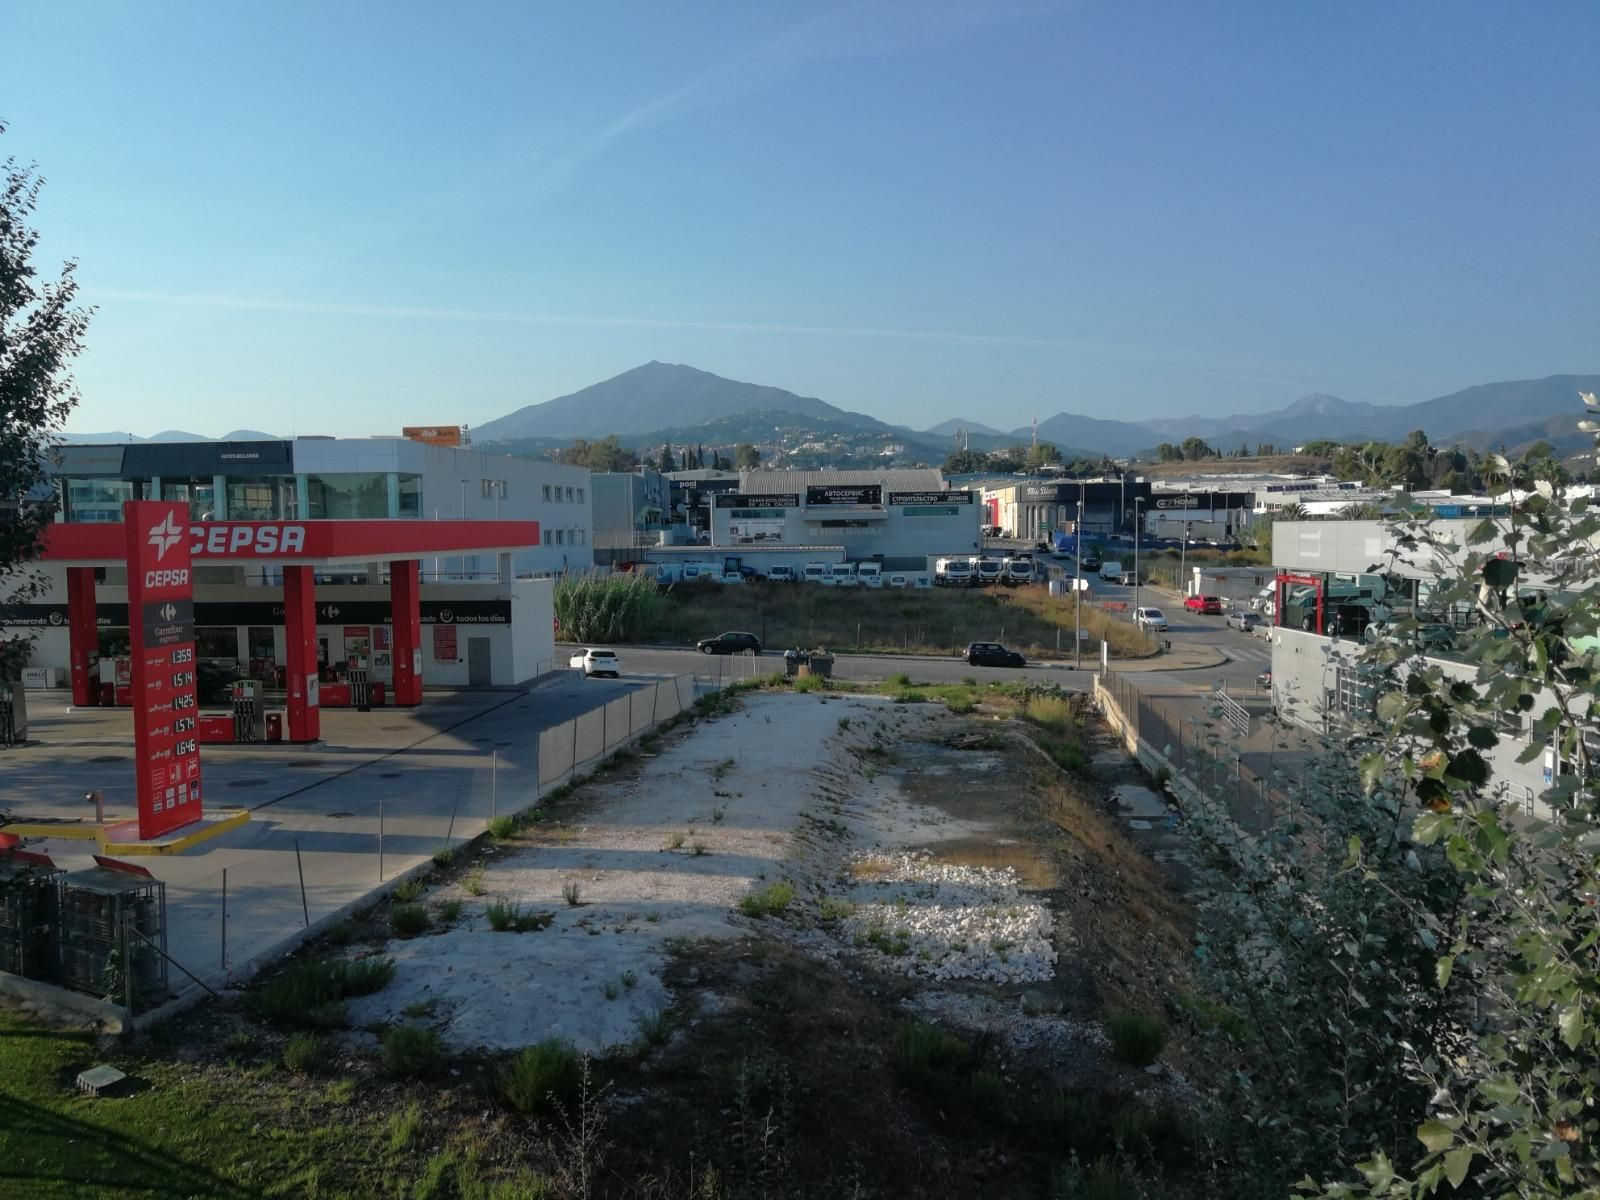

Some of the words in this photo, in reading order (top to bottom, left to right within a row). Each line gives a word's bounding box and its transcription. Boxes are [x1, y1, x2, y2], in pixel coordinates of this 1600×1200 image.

[190, 526, 306, 554] CEPSA
[145, 569, 189, 588] CEPSA
[154, 624, 184, 637] Carrefour
